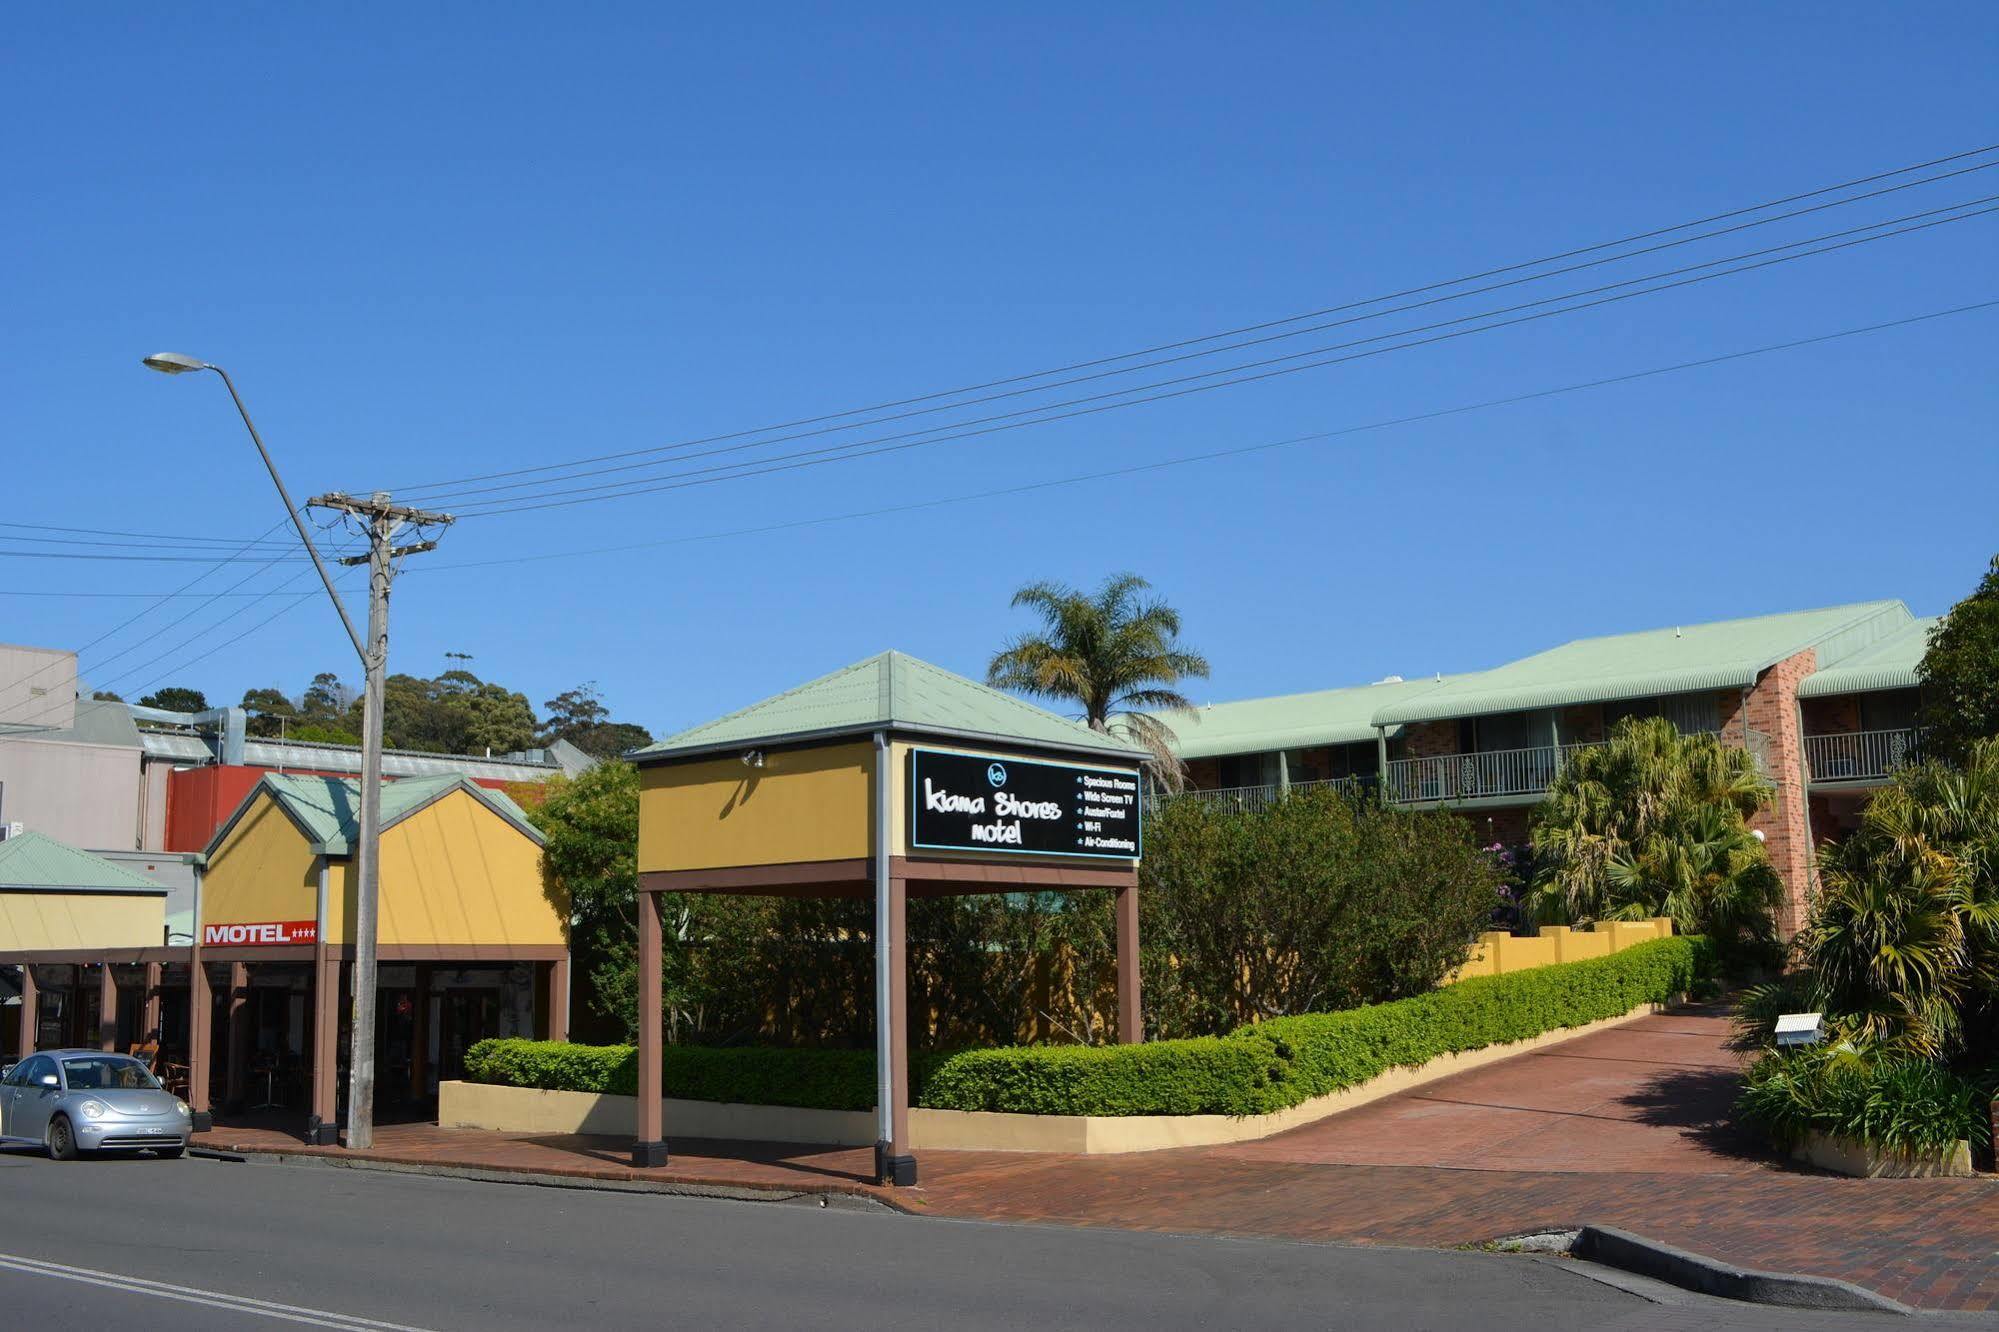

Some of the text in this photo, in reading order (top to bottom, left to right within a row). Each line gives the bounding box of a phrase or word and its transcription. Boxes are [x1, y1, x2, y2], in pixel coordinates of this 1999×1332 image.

[1083, 775, 1136, 790] Spacious Rooms
[994, 791, 1063, 820] Shores
[1083, 791, 1134, 805] Wide Screen TV
[971, 819, 1023, 844] motel
[1084, 836, 1136, 852] Air-Conditioning
[205, 924, 291, 943] MOTEL
